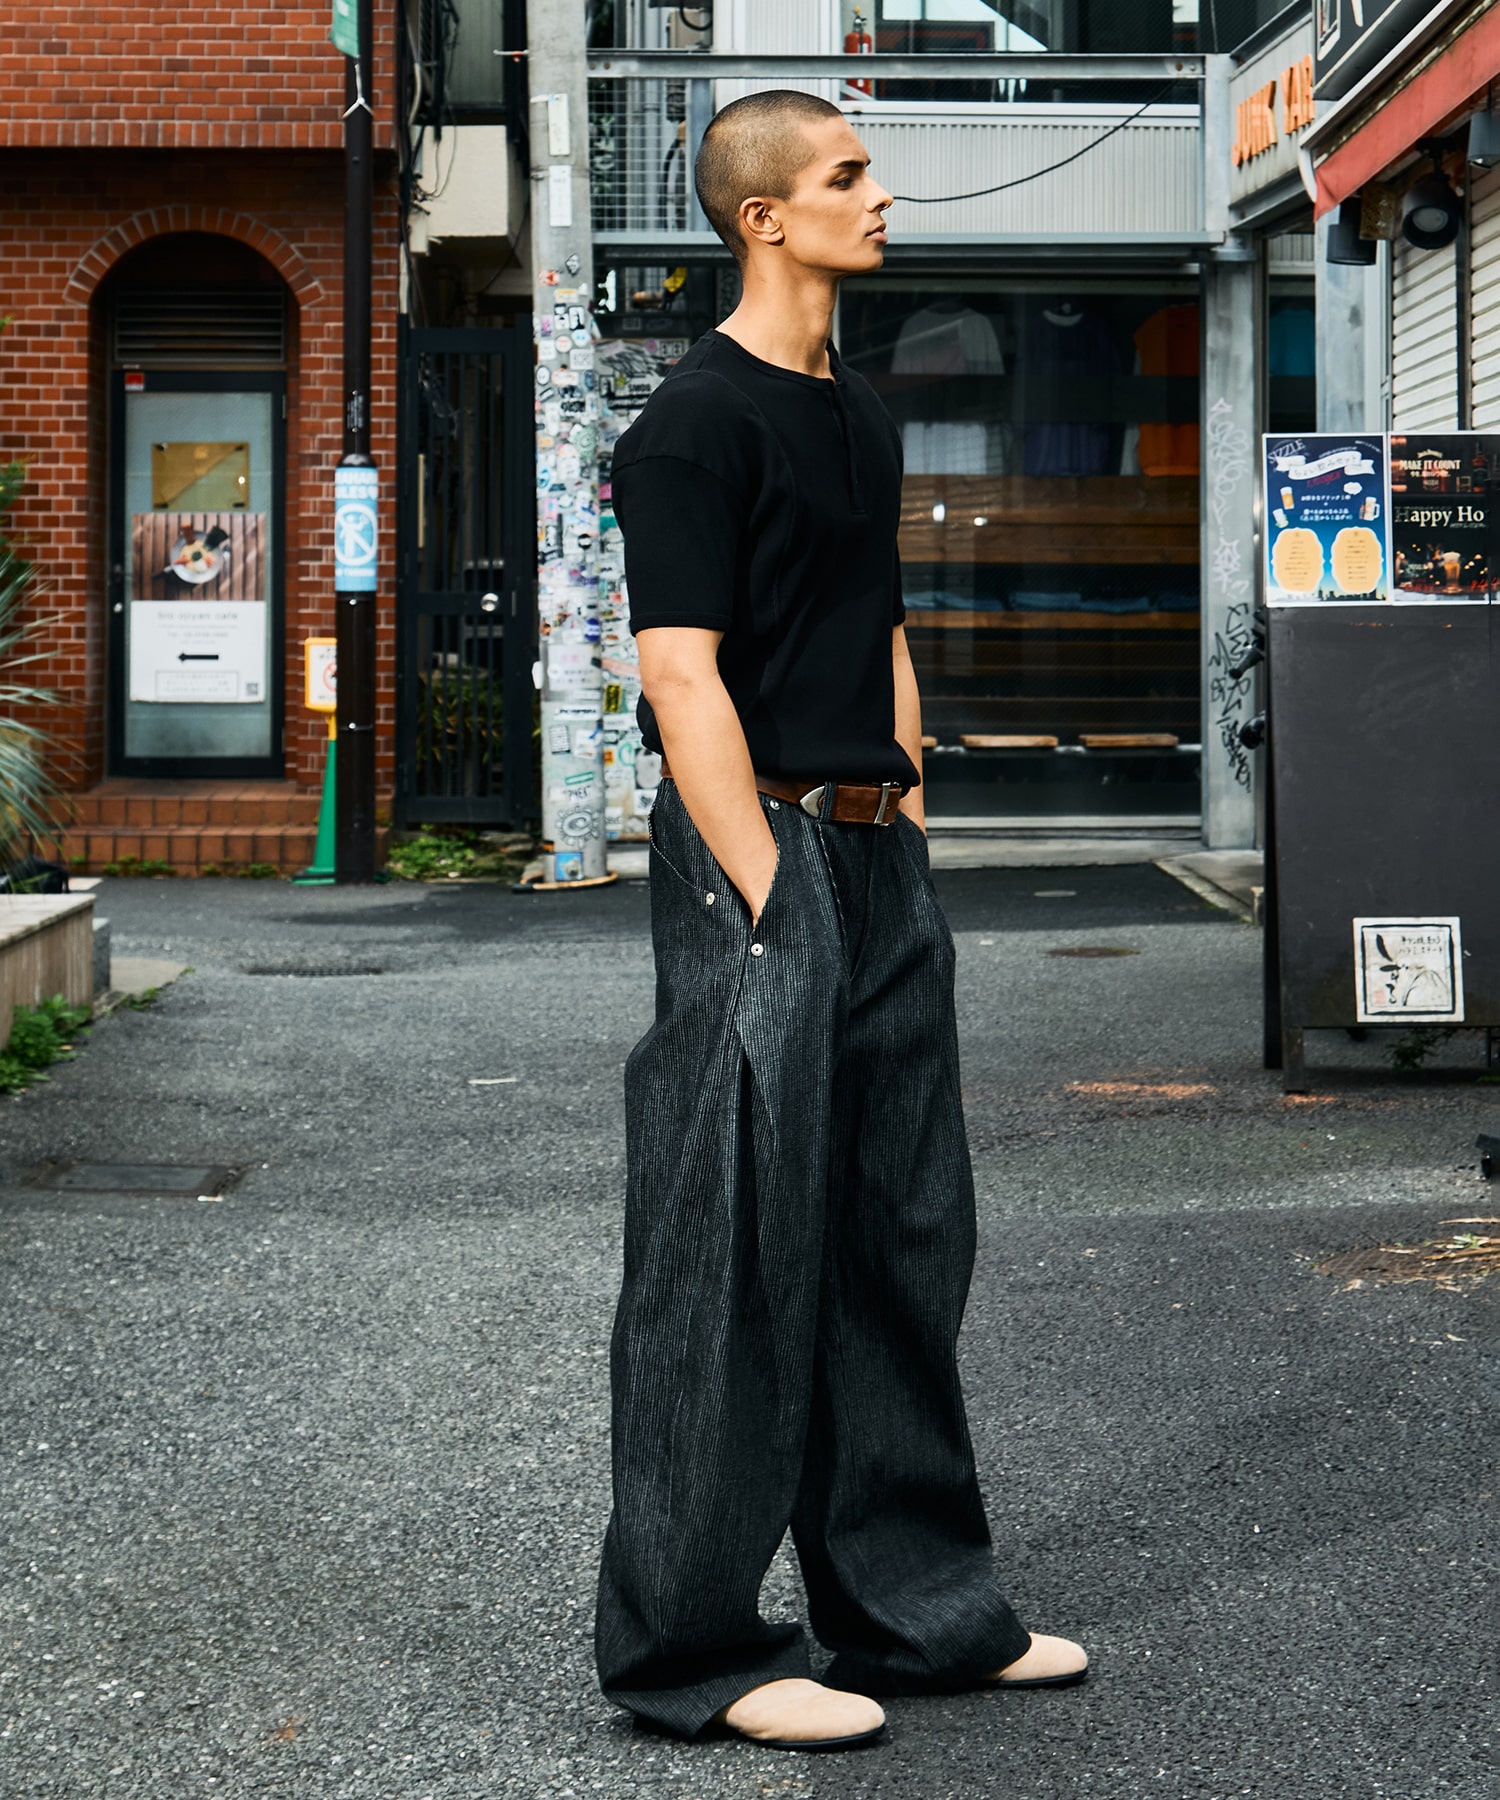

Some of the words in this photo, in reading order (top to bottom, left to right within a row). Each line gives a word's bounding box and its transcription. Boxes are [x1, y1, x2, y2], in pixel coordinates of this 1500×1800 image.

[1232, 80, 1277, 167] JUNK
[1268, 438, 1305, 464] SIZZLE
[1400, 459, 1422, 471] MAKE
[1423, 460, 1432, 470] IT
[1433, 459, 1462, 470] COUNT
